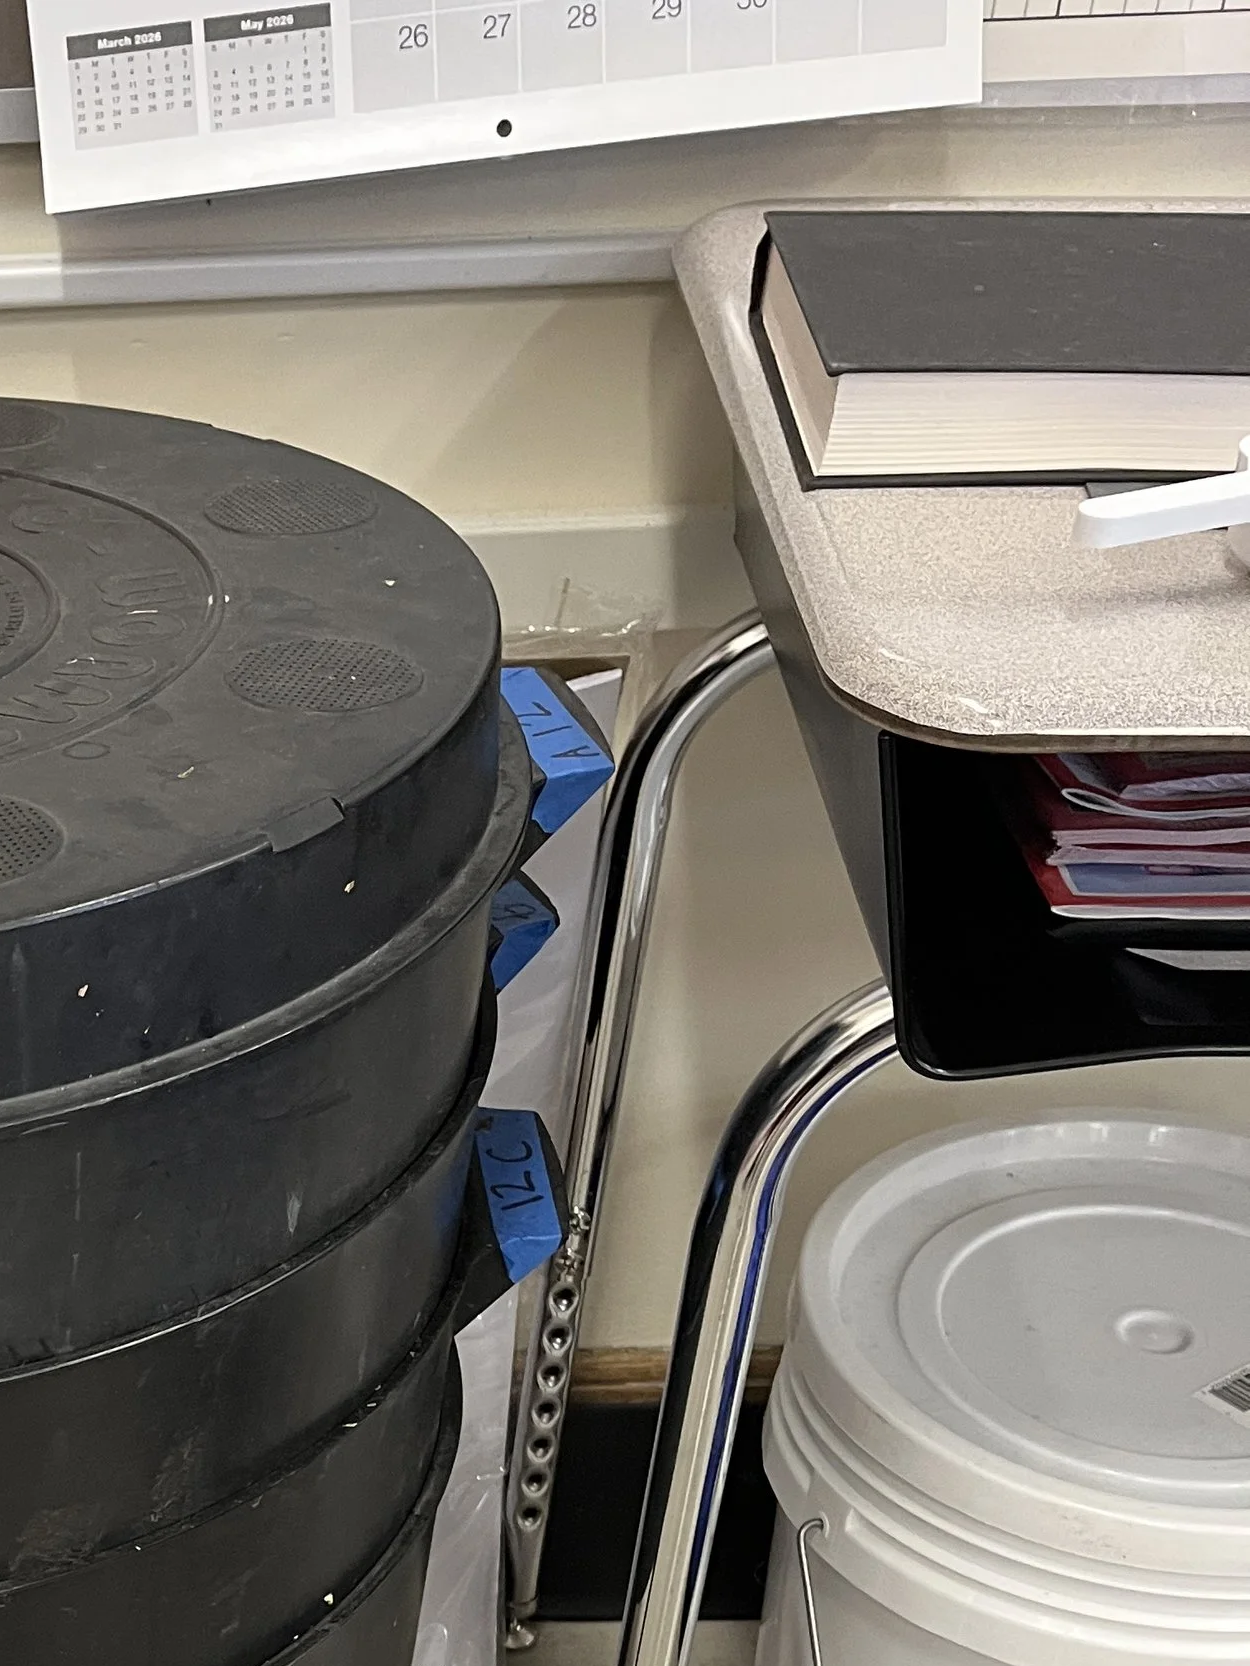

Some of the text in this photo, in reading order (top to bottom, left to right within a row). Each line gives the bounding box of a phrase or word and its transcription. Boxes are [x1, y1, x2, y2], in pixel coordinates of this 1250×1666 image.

[240, 14, 294, 31] May 2026
[398, 23, 430, 50] 26
[482, 13, 512, 40] 27
[566, 4, 598, 30] 28
[97, 32, 162, 50] March 2026
[486, 1140, 545, 1212] 12C
